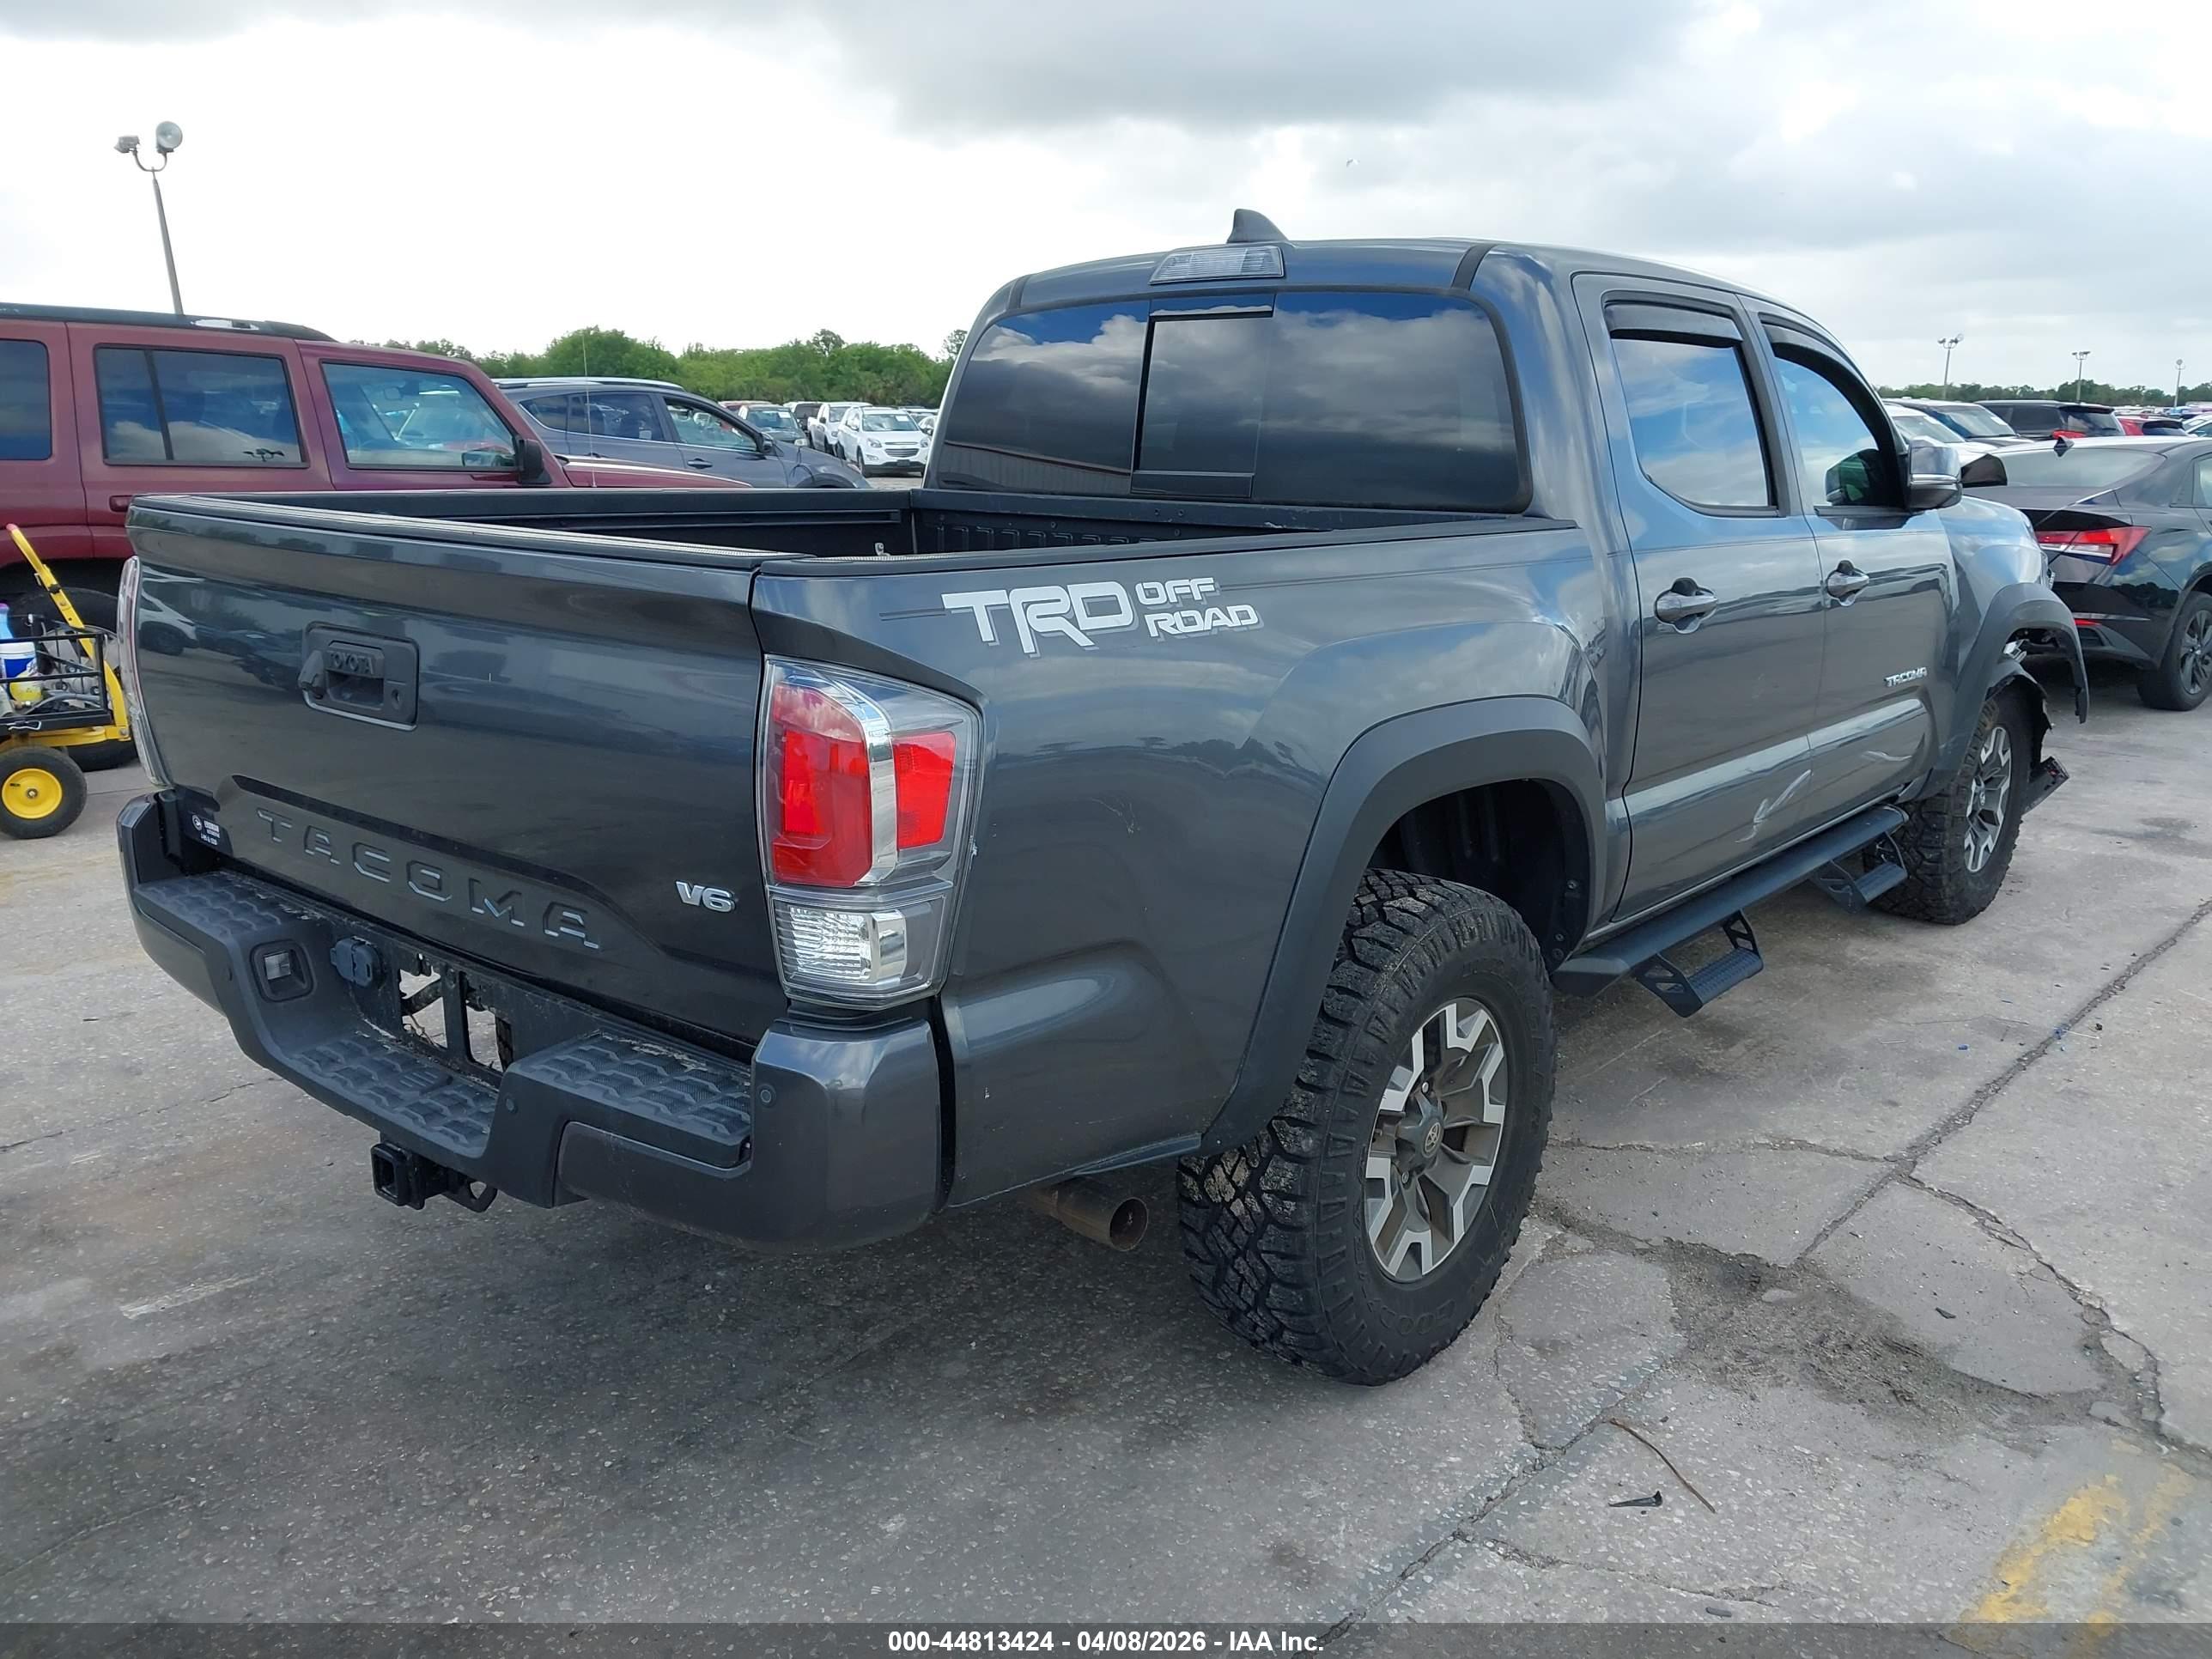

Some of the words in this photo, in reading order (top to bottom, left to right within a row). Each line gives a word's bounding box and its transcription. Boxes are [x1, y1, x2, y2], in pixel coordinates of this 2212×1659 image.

[941, 580, 1136, 655] TRD
[1135, 577, 1217, 606] OFF
[1144, 604, 1261, 637] ROAD
[325, 650, 374, 675] TOYOTA
[1885, 666, 1928, 687] TACOMA
[257, 808, 600, 949] TACOMA
[675, 880, 736, 913] V6
